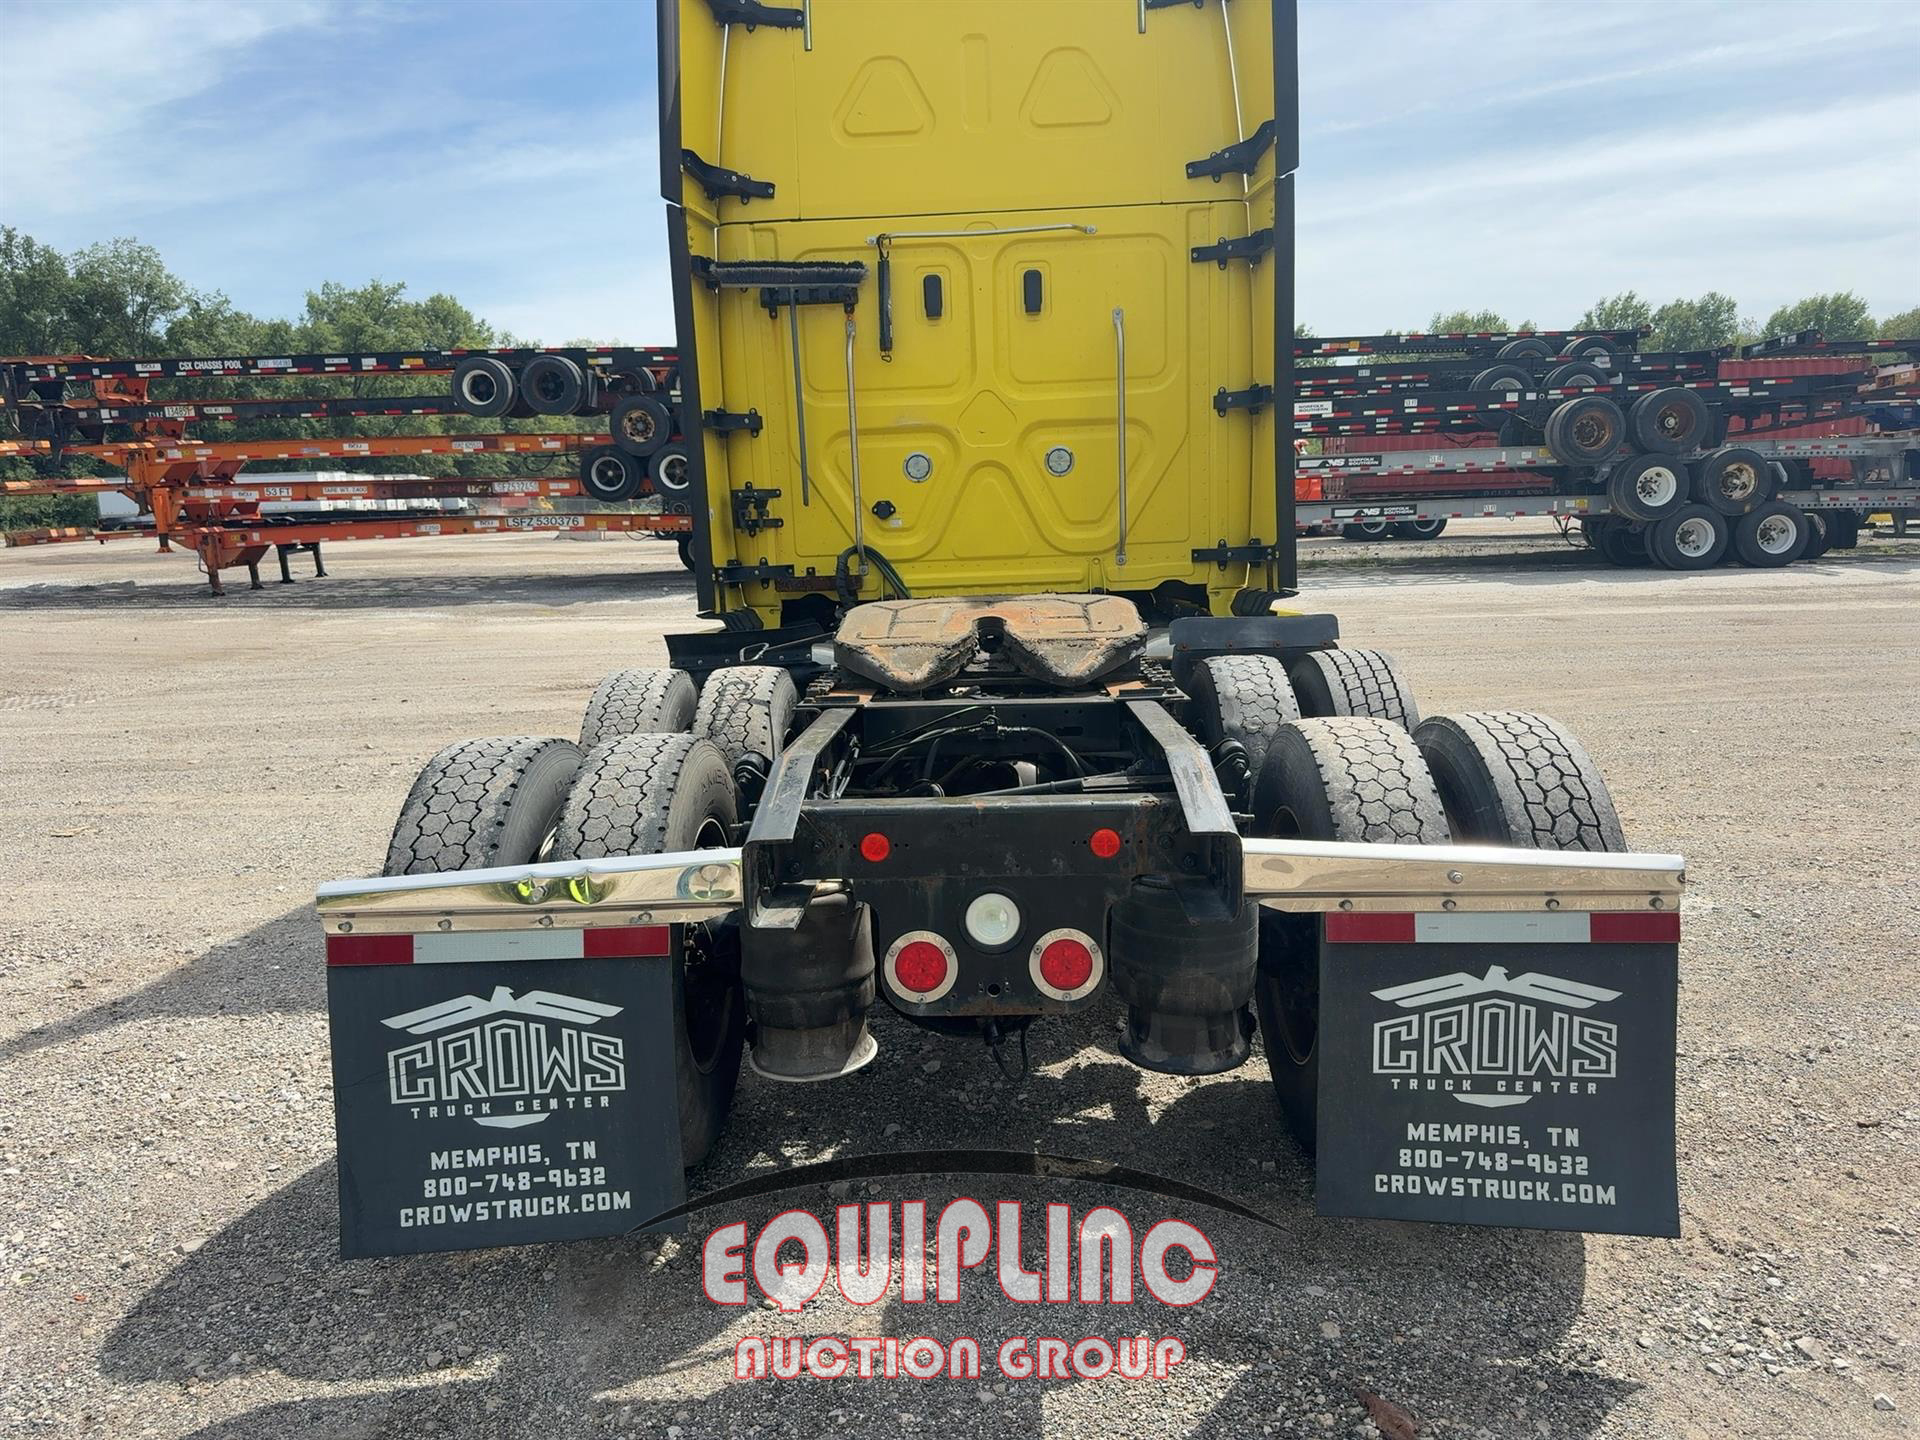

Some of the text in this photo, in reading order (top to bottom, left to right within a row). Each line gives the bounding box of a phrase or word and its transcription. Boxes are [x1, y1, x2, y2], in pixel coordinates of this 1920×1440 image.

[179, 360, 242, 370] CSX CHASSIS POOL
[265, 487, 290, 496] 53 FT
[506, 516, 579, 528] LSFZ 530376
[1372, 998, 1618, 1078] CROWS
[387, 1018, 626, 1105] CROWS
[1391, 1078, 1598, 1094] TRUCK CENTER
[410, 1095, 610, 1120] TRUCK CENTER
[1407, 1122, 1580, 1149] MEMPHIS, TN
[429, 1141, 598, 1171] MEMPHIS, TN
[1399, 1148, 1590, 1176] 800-748-9632
[423, 1166, 607, 1199] 800-748-9632
[1374, 1174, 1617, 1206] CROWSTRUCK.COM
[399, 1191, 632, 1228] CROWSTRUCK.COM
